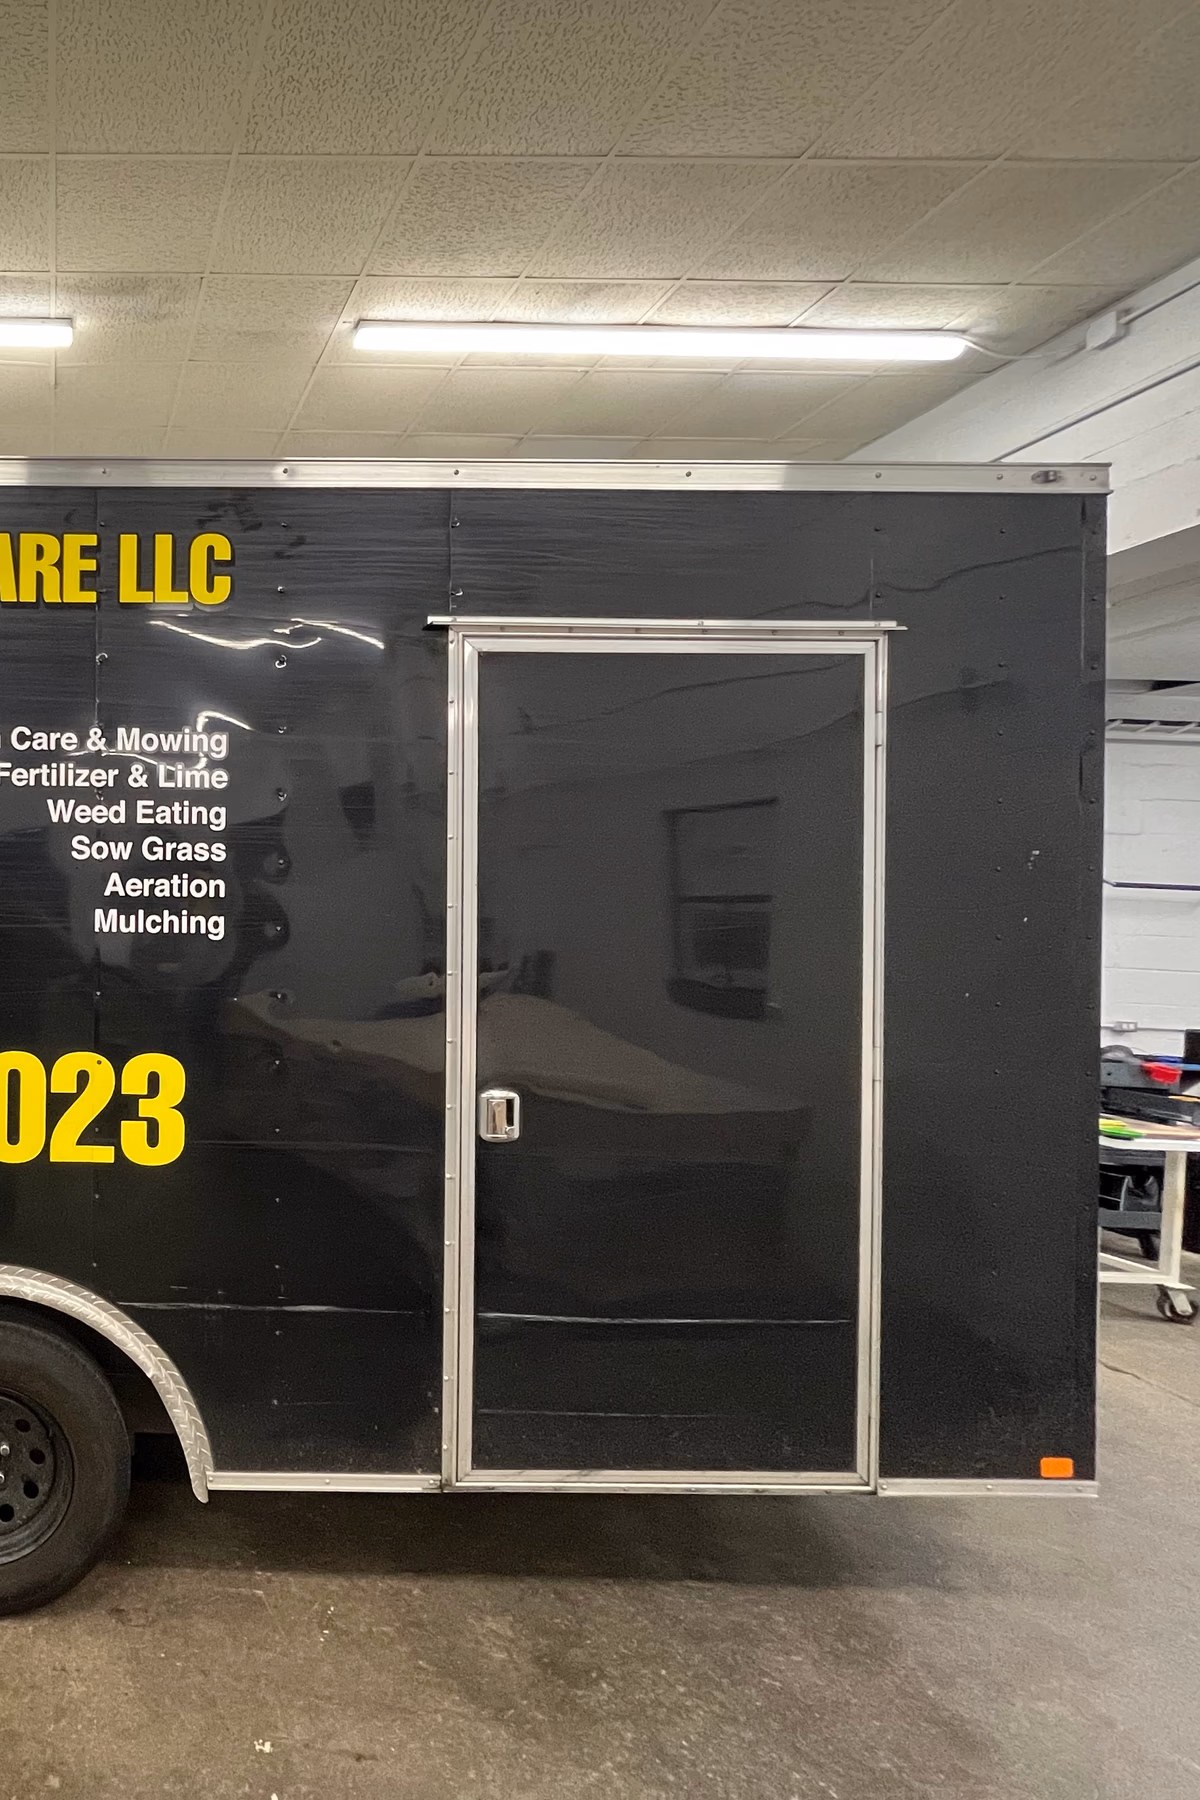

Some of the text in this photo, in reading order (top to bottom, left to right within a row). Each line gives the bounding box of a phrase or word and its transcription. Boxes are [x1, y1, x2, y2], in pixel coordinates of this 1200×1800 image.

[118, 533, 232, 606] LLC
[11, 727, 77, 752] Care
[86, 728, 107, 752] &
[117, 728, 227, 758] Mowing
[128, 764, 147, 787] &
[159, 764, 228, 789] Lime
[48, 800, 227, 831] Weed Eating
[71, 835, 227, 861] Sow Grass
[104, 873, 225, 897] Aeration
[94, 909, 225, 940] Mulching
